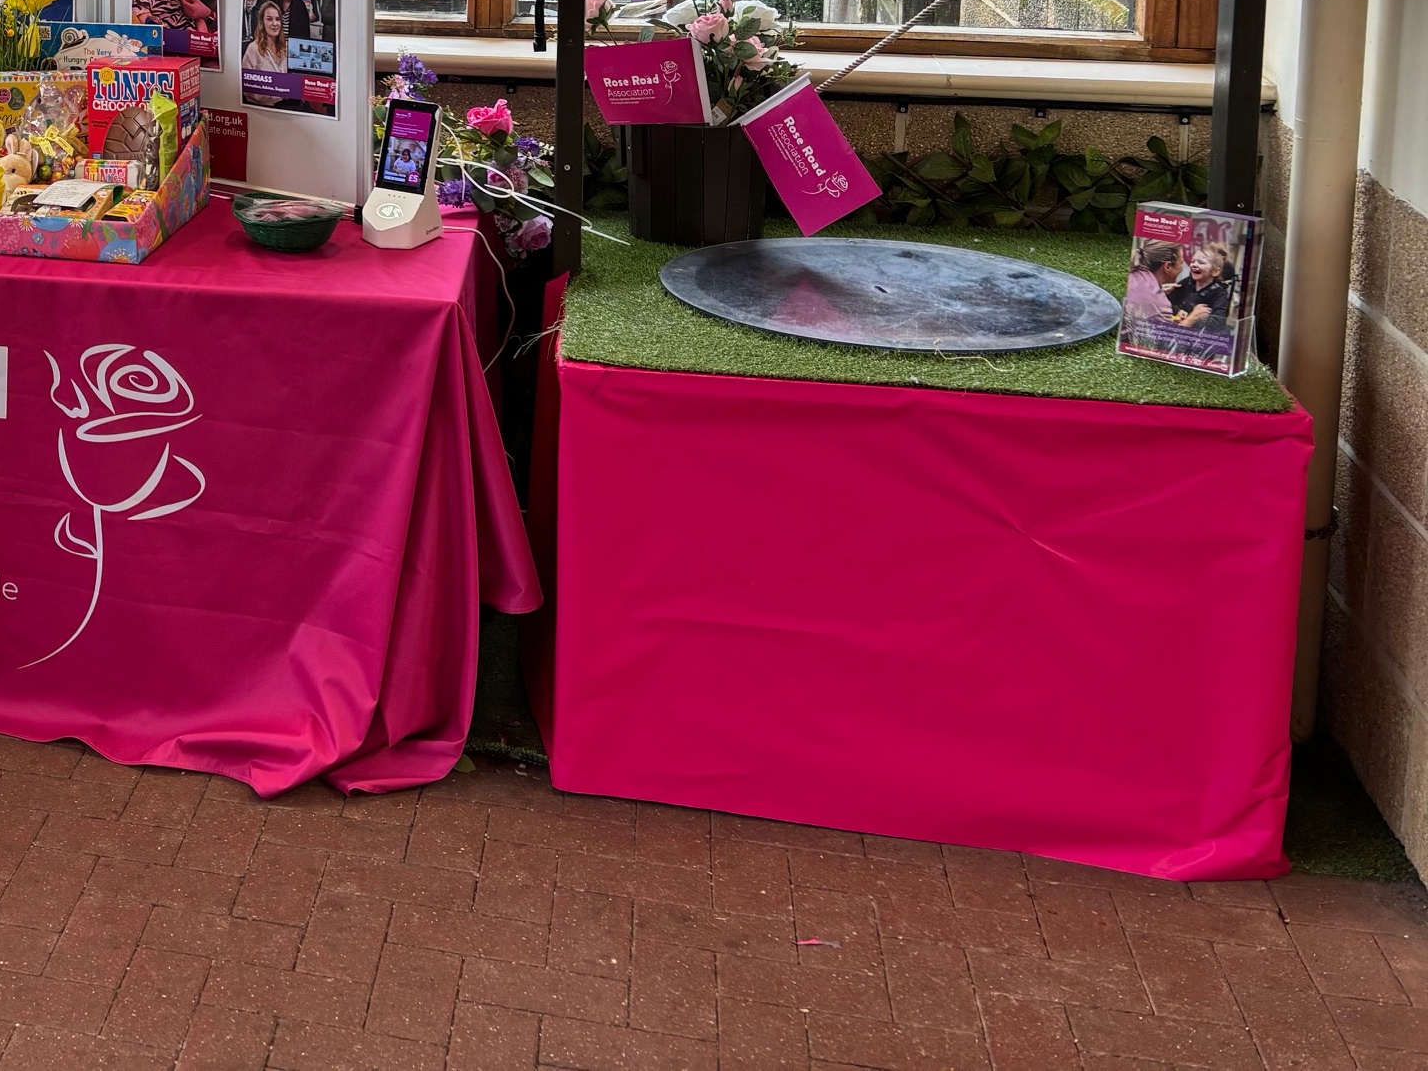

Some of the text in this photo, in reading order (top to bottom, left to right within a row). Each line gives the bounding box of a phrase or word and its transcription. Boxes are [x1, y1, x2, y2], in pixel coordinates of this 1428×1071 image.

[63, 56, 87, 64] Hungry
[603, 73, 660, 87] Rose Road
[607, 87, 654, 97] Association
[222, 128, 246, 138] online
[774, 123, 809, 175] Association
[783, 115, 804, 145] Rose
[801, 145, 827, 177] Road
